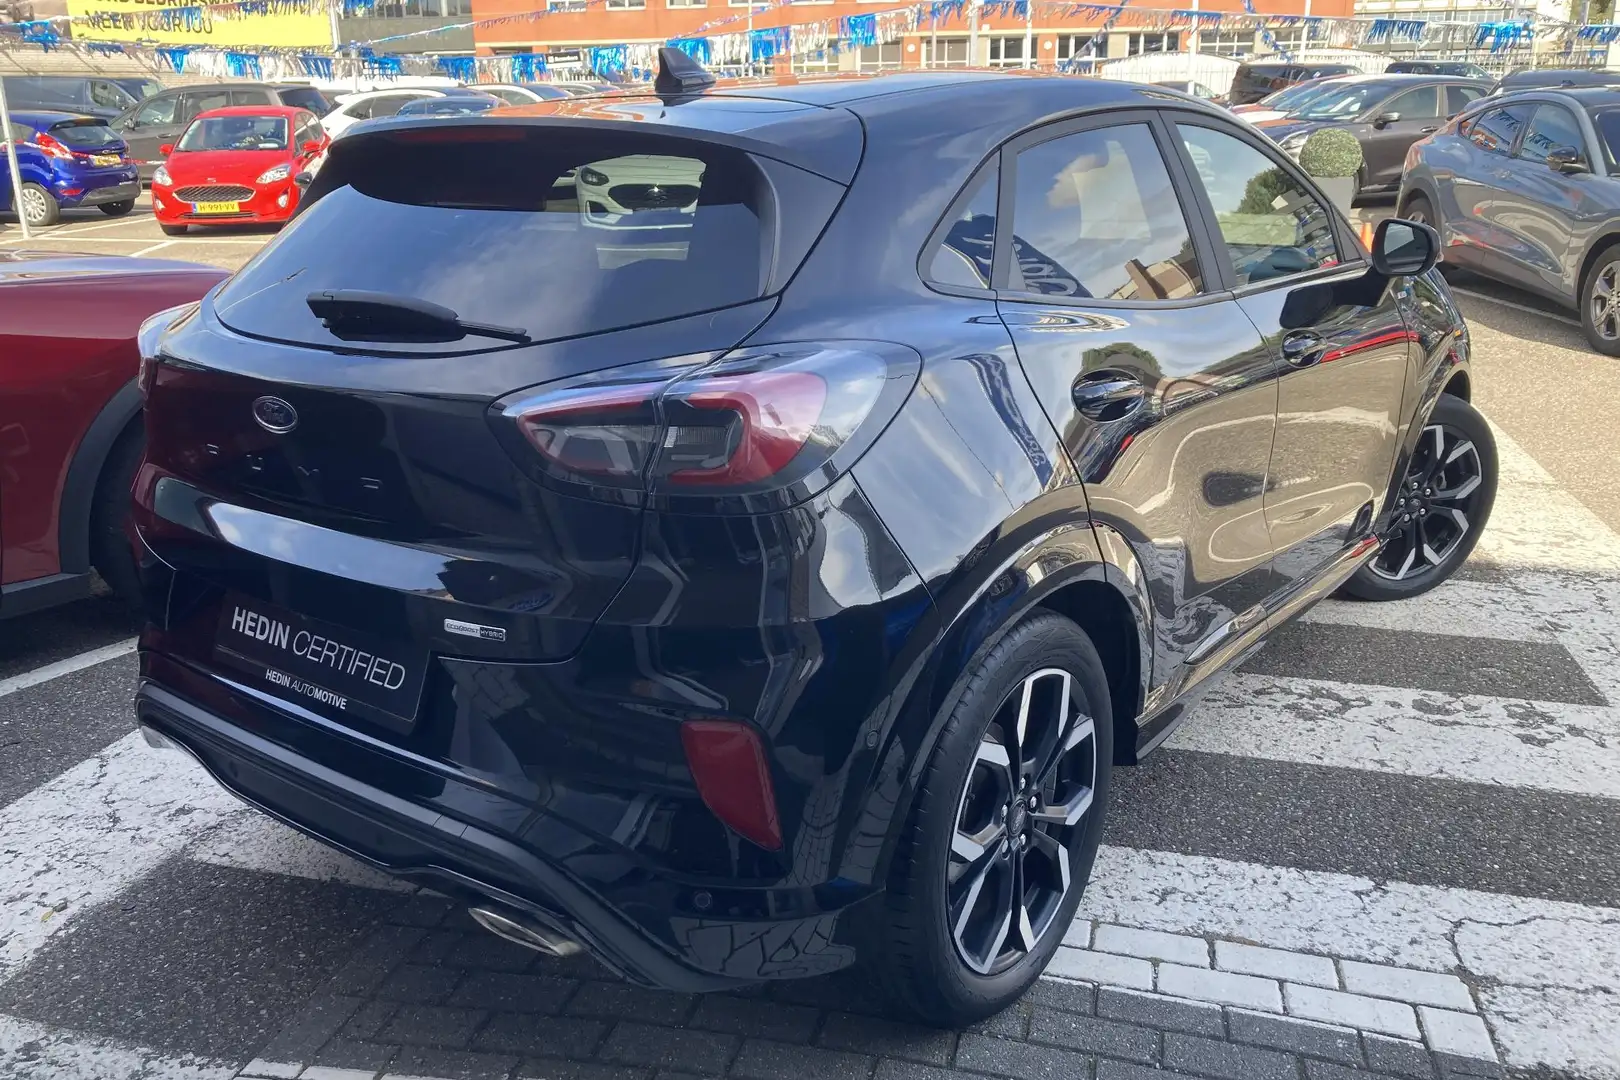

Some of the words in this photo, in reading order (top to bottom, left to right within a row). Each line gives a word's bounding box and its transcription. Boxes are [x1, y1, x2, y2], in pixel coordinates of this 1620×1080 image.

[231, 606, 290, 649] HEDIN
[292, 630, 406, 690] CERTIFIED
[265, 668, 292, 688] HEDIN
[290, 679, 348, 710] AUTOMOTIVE
